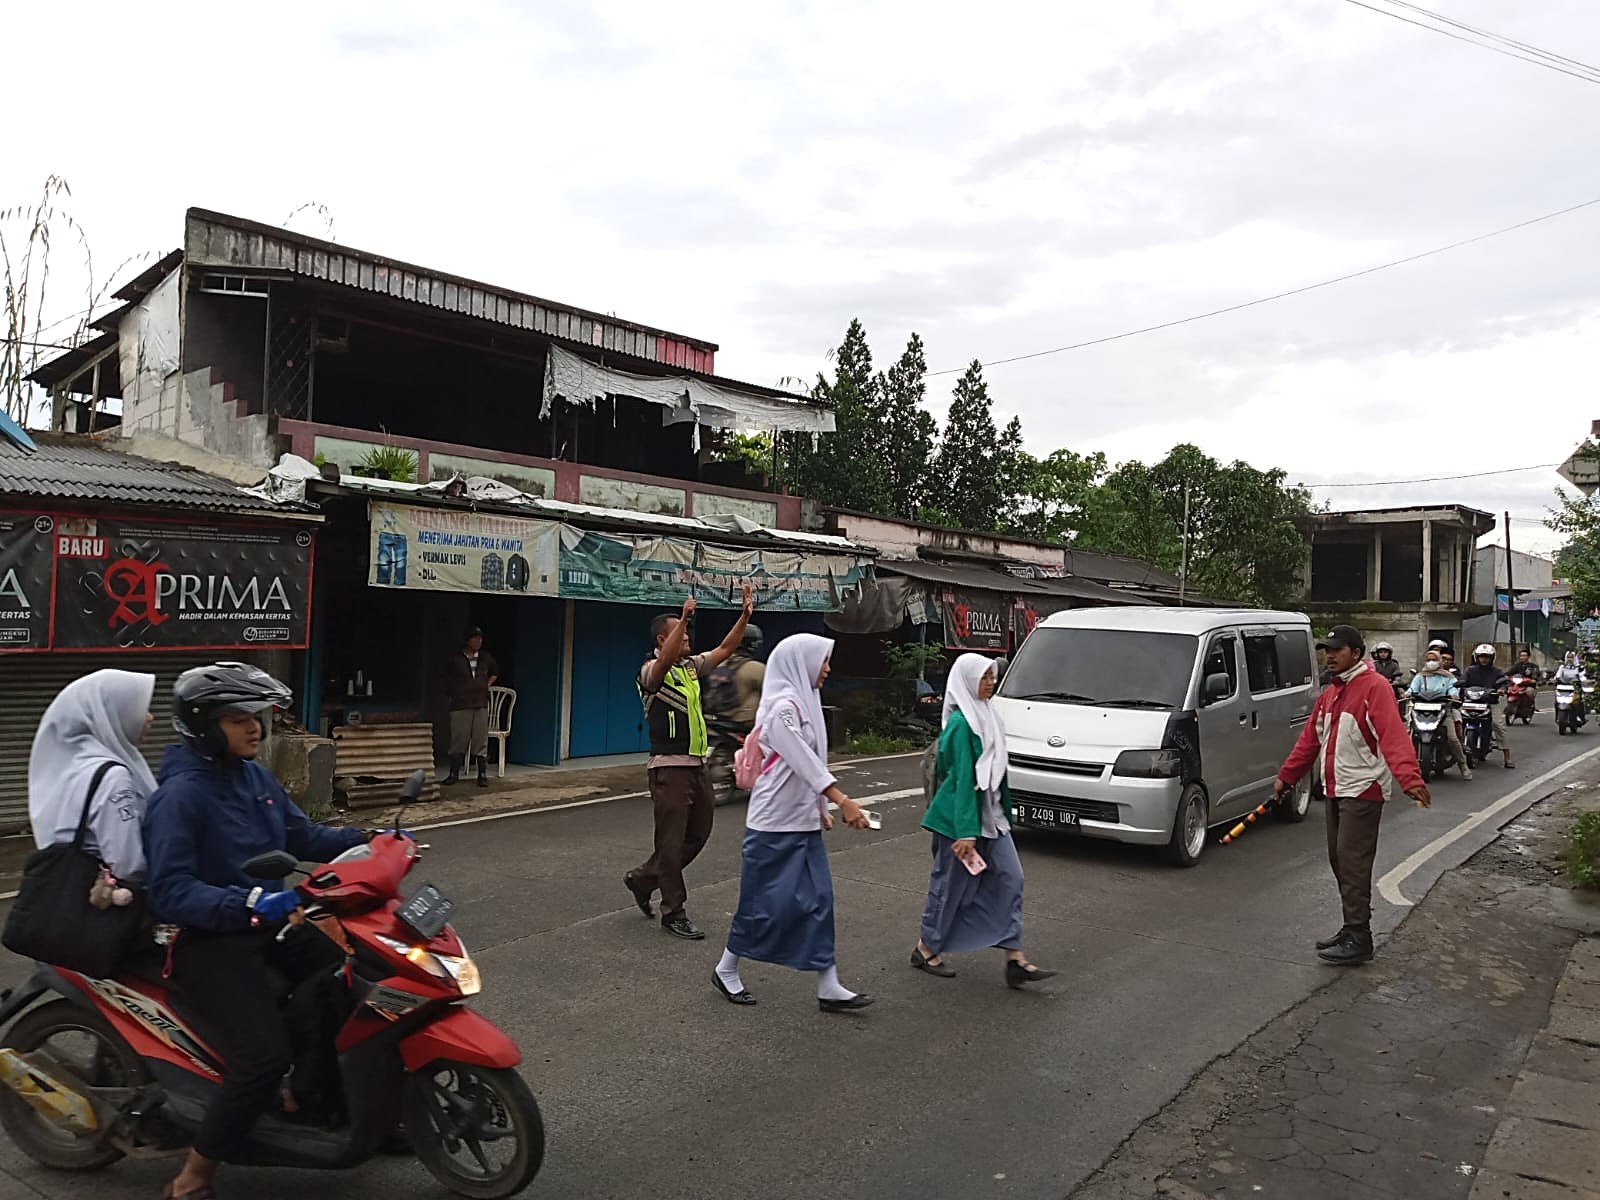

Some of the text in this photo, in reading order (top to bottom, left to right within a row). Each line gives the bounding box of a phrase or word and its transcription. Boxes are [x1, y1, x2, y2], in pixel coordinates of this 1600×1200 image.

[58, 537, 104, 557] BARU
[418, 530, 453, 546] MENERIMA
[454, 535, 479, 548] JAHITAN
[480, 537, 494, 550] PRIA
[501, 539, 523, 552] WANITA
[422, 552, 449, 565] VERMAK
[179, 612, 202, 620] HADIR
[203, 612, 228, 620] DALAM
[1019, 806, 1025, 817] B
[1031, 807, 1054, 821] 2409
